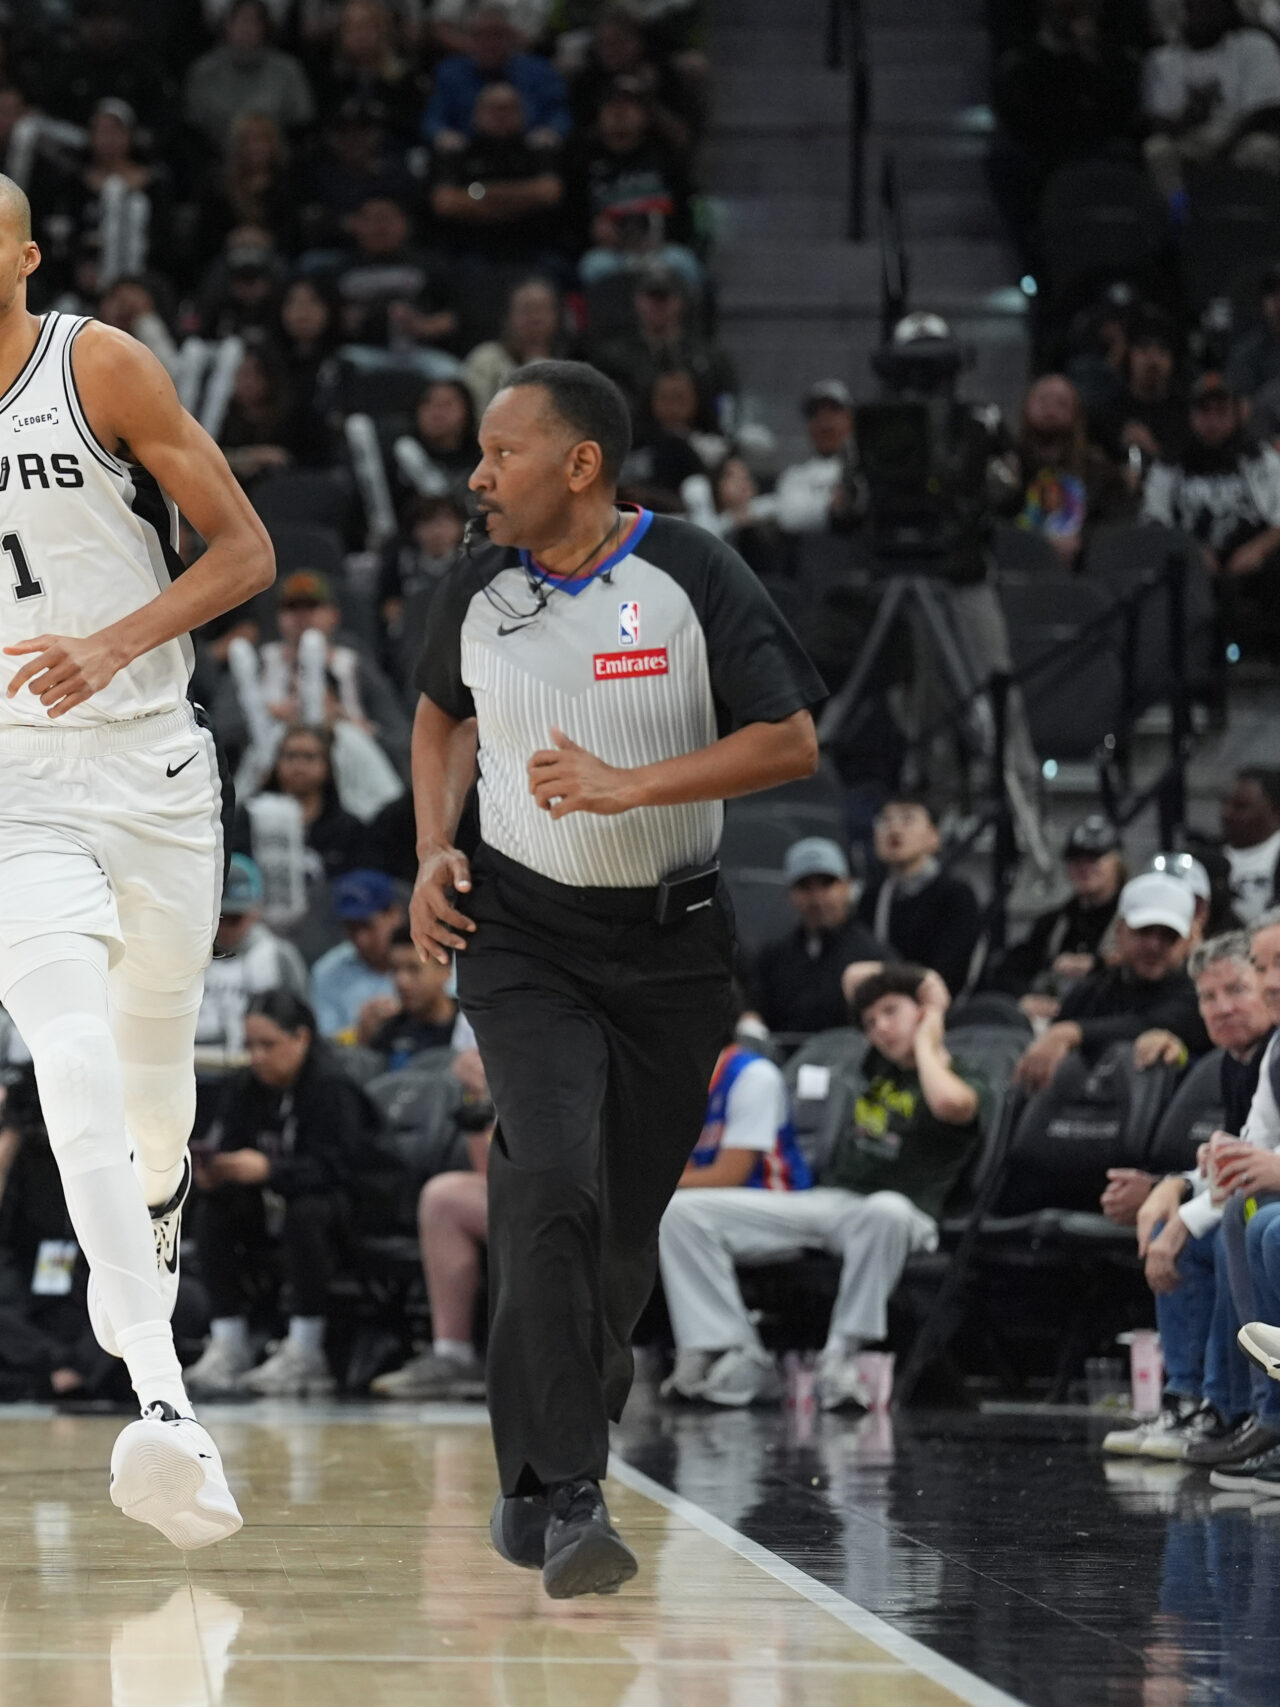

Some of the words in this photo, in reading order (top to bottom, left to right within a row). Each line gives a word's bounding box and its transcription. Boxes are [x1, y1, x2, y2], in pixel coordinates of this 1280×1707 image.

[17, 413, 53, 427] LEDGER
[0, 529, 46, 603] 1
[595, 655, 667, 675] Emirates
